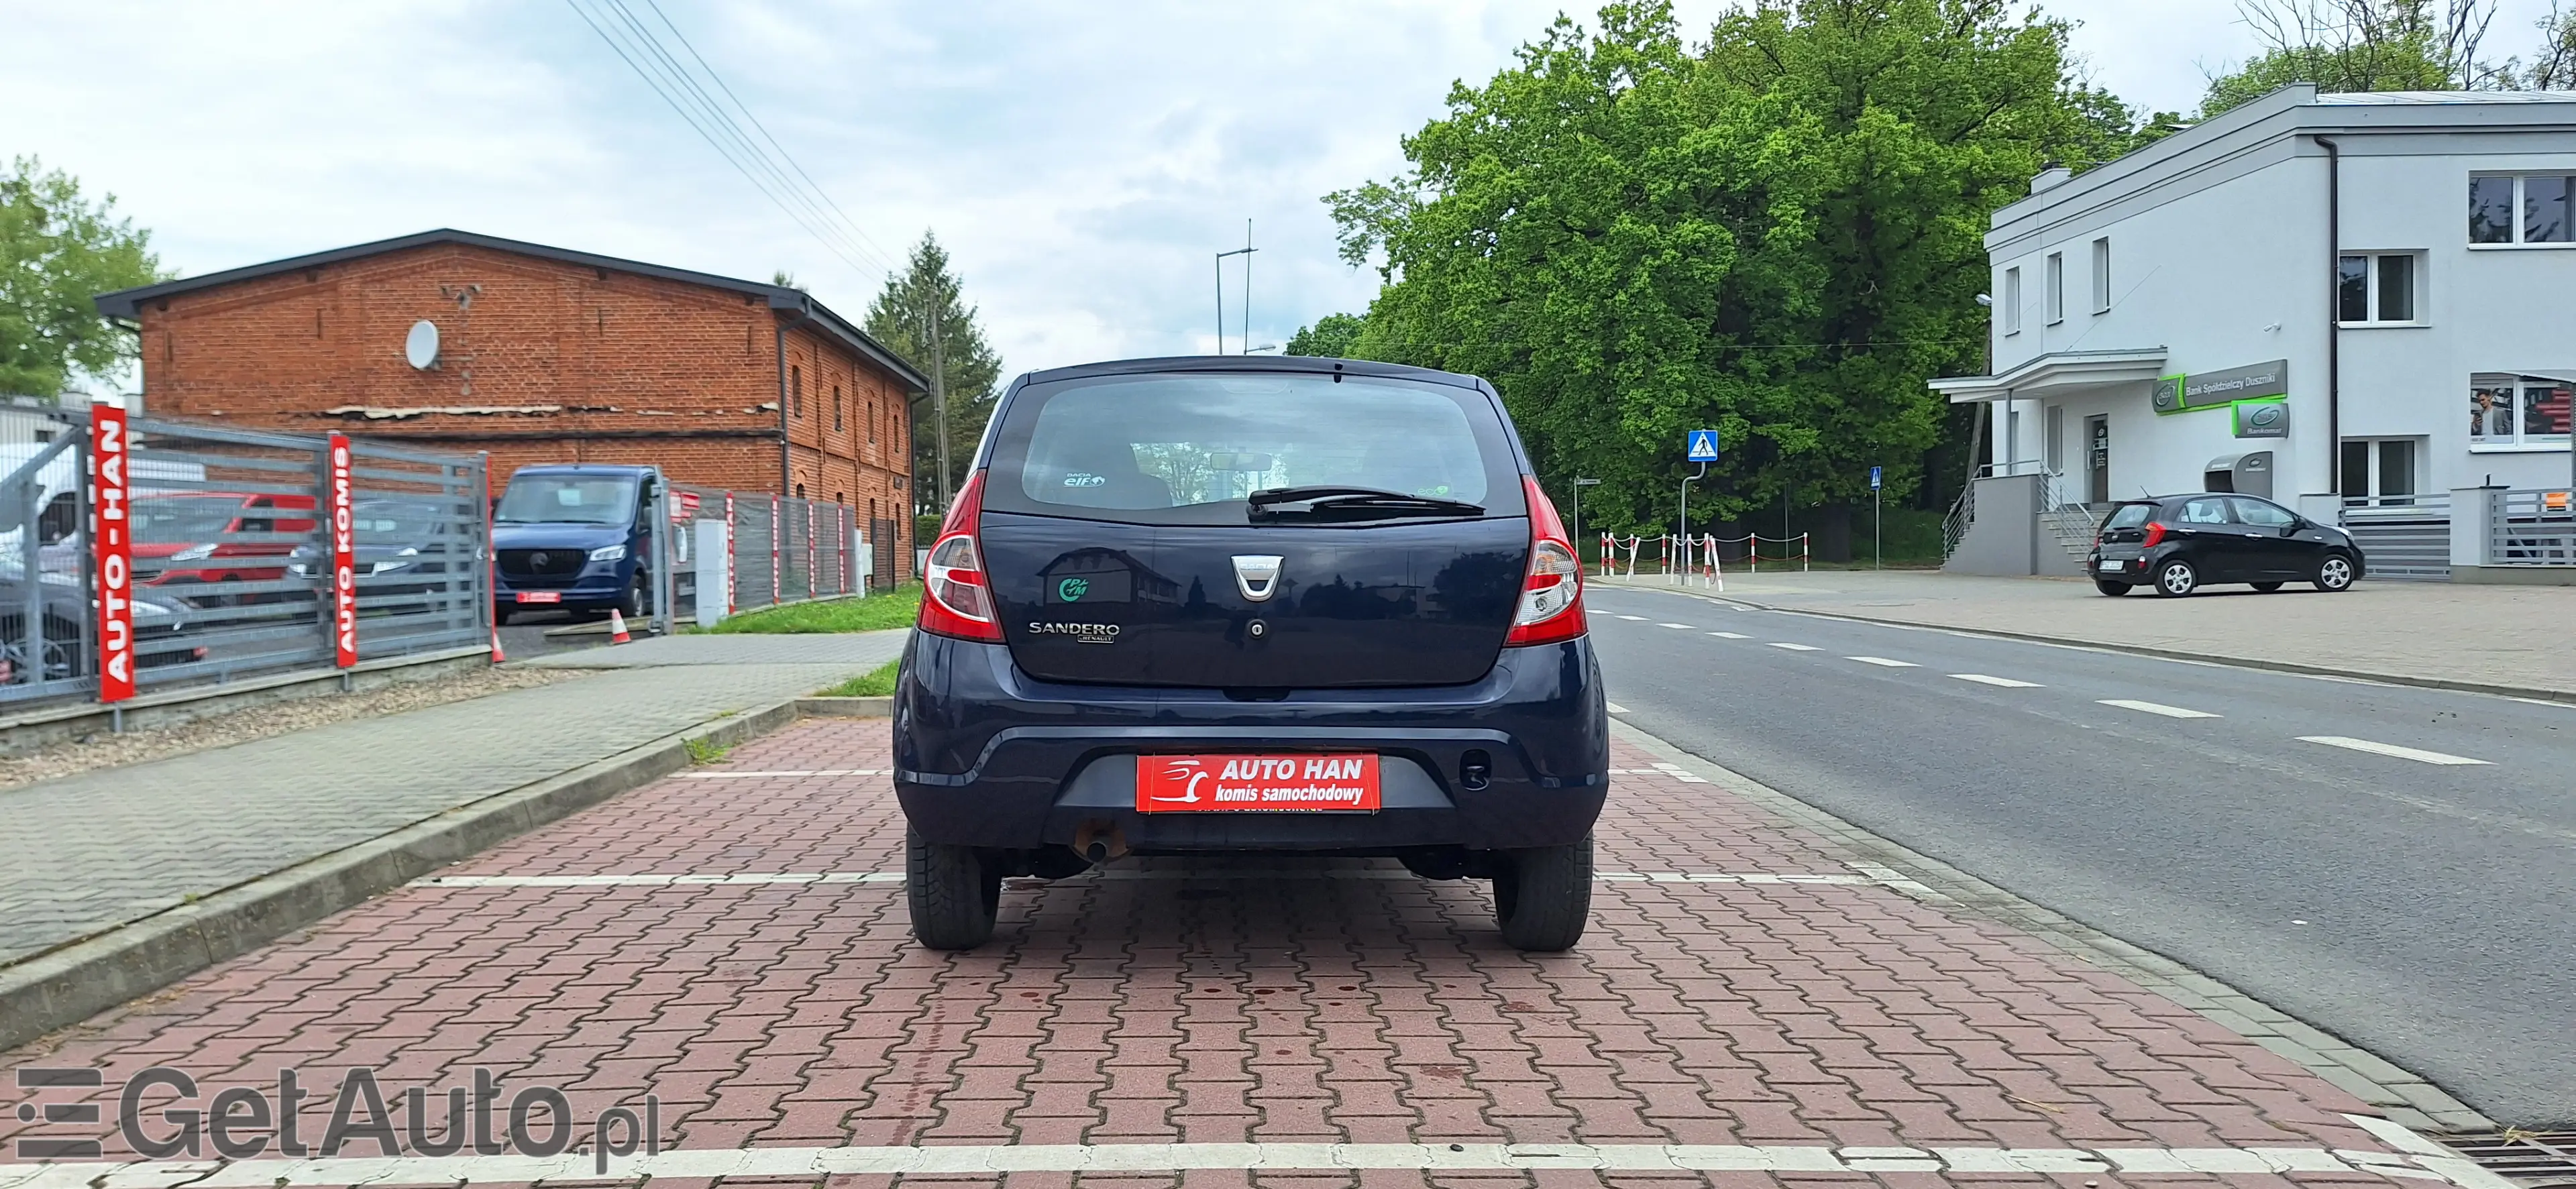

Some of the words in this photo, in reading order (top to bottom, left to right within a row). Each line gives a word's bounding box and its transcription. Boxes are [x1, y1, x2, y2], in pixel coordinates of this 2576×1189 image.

[2186, 386, 2202, 396] Bank
[2203, 380, 2243, 394] Spółdzielczy
[2245, 373, 2275, 386] Duszniki
[334, 447, 352, 553] KOMIS
[338, 565, 356, 653] AUTO
[1029, 622, 1120, 636] SANDERO
[1220, 760, 1296, 779] AUTO
[1303, 759, 1363, 779] HAN
[1215, 783, 1258, 801] komis
[1261, 783, 1364, 805] samochodowy
